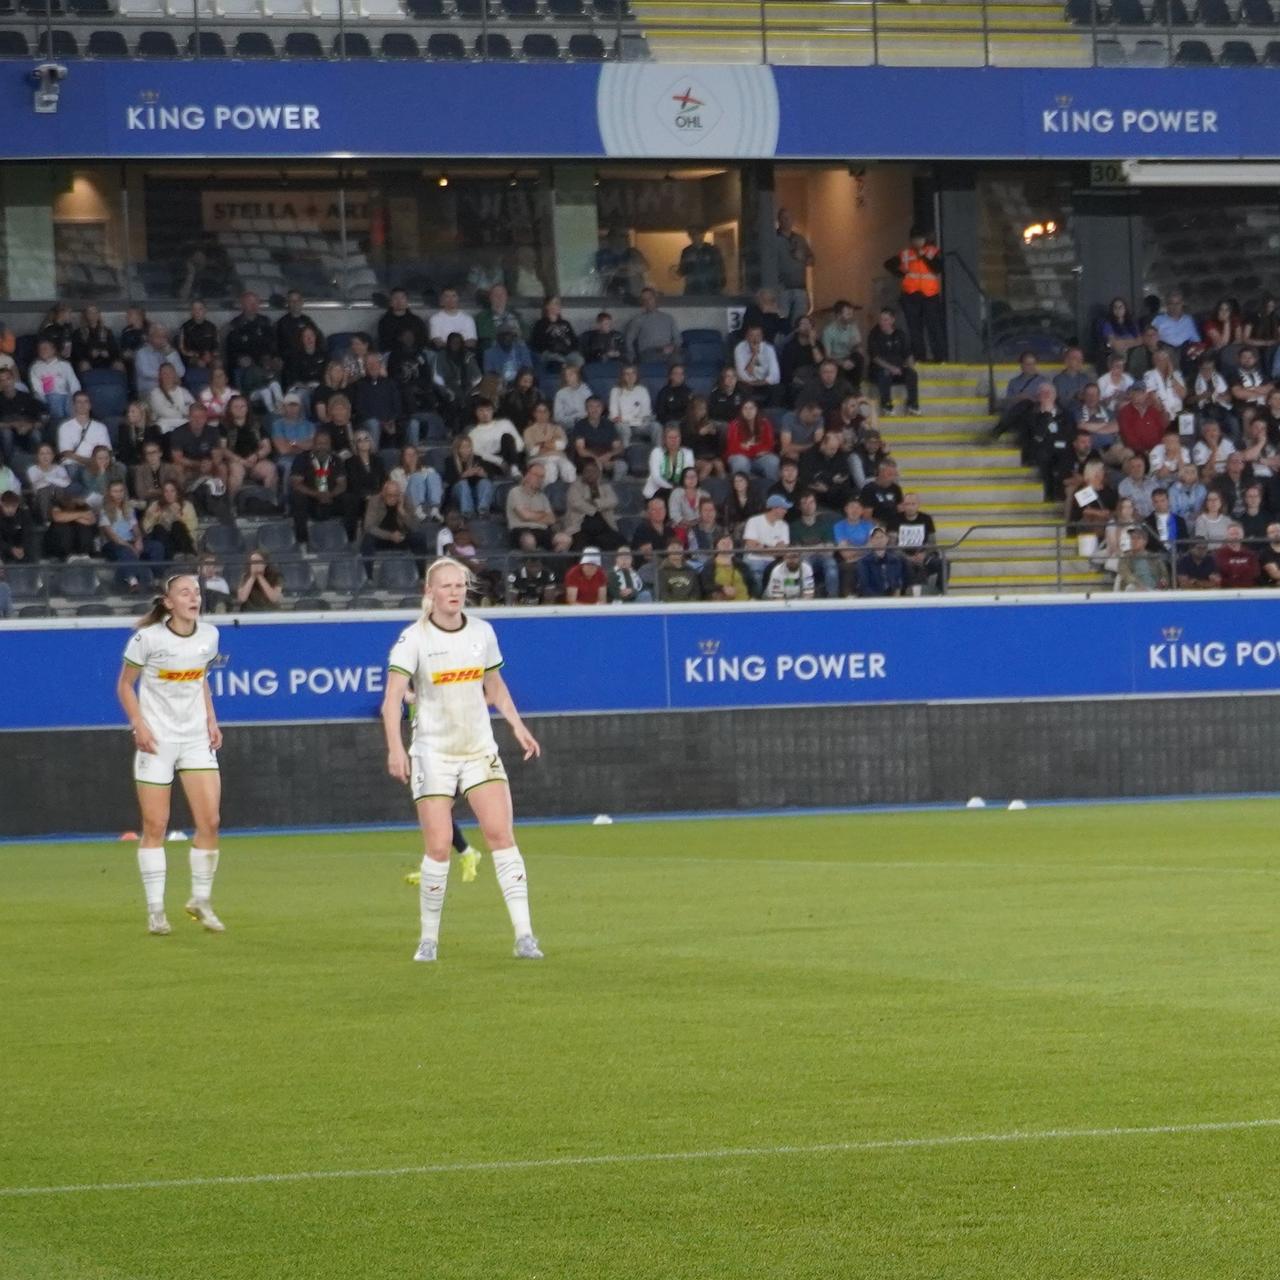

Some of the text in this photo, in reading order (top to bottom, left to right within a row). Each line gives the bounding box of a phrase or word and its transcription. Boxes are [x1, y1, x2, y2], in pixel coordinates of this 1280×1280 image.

[127, 106, 321, 131] KING POWER
[675, 115, 703, 129] OHL
[1042, 108, 1218, 133] KING POWER
[213, 203, 297, 220] STELLA
[685, 652, 887, 683] KING POWER
[1149, 641, 1227, 669] KING
[289, 666, 383, 695] POWE
[438, 668, 484, 684] DHL
